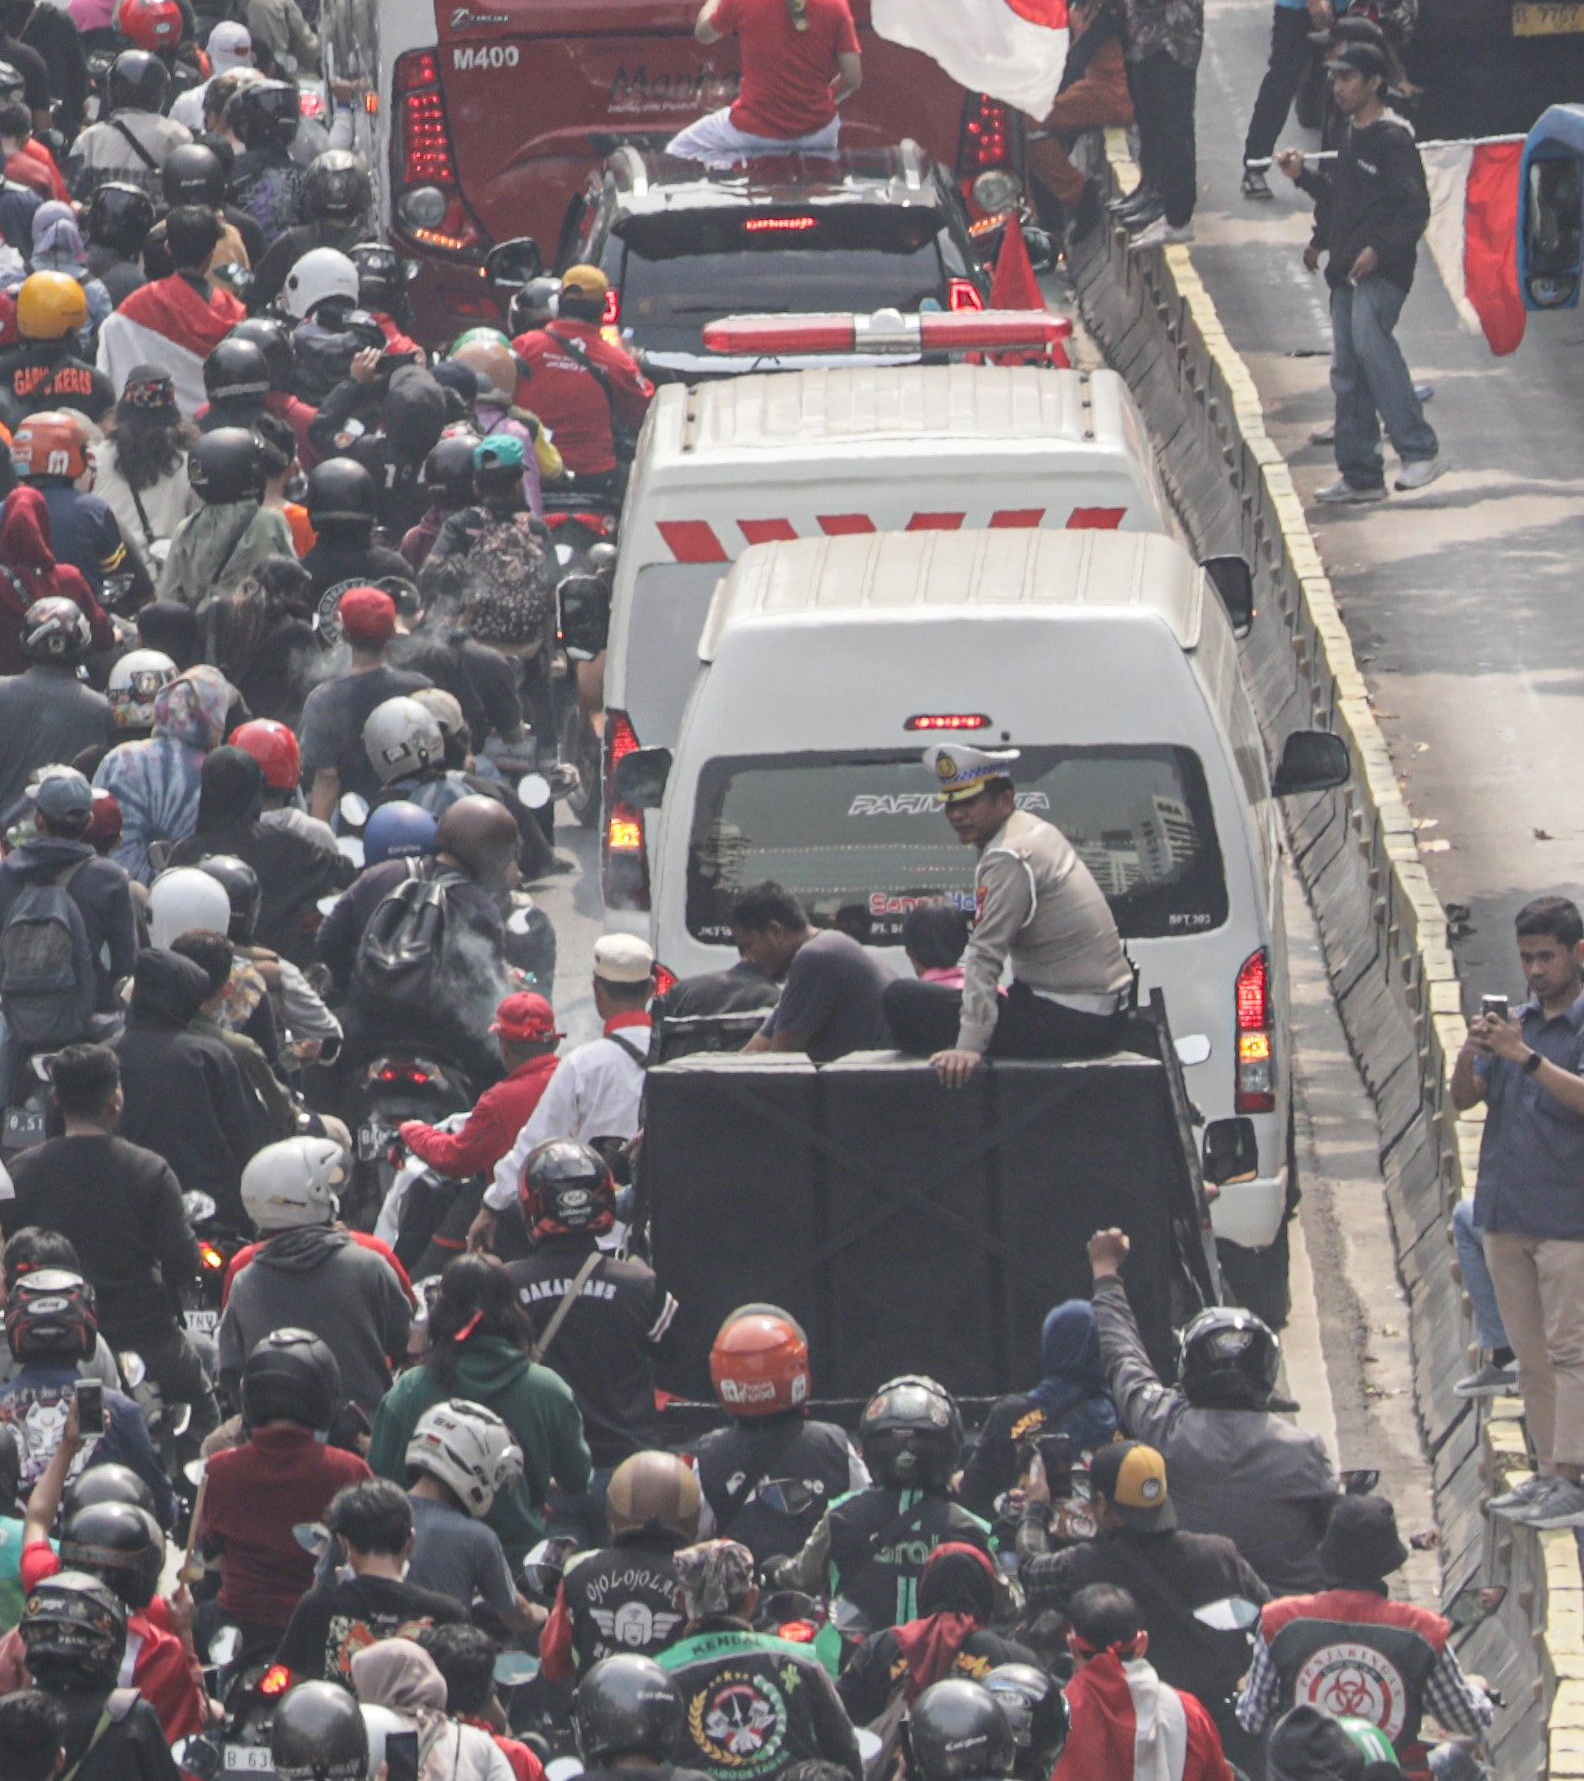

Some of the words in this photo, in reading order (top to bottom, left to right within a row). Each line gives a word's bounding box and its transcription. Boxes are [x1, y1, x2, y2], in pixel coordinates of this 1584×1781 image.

[452, 44, 520, 71] M400
[519, 1278, 617, 1305] JAKARANS
[691, 1635, 760, 1655] KENDAL
